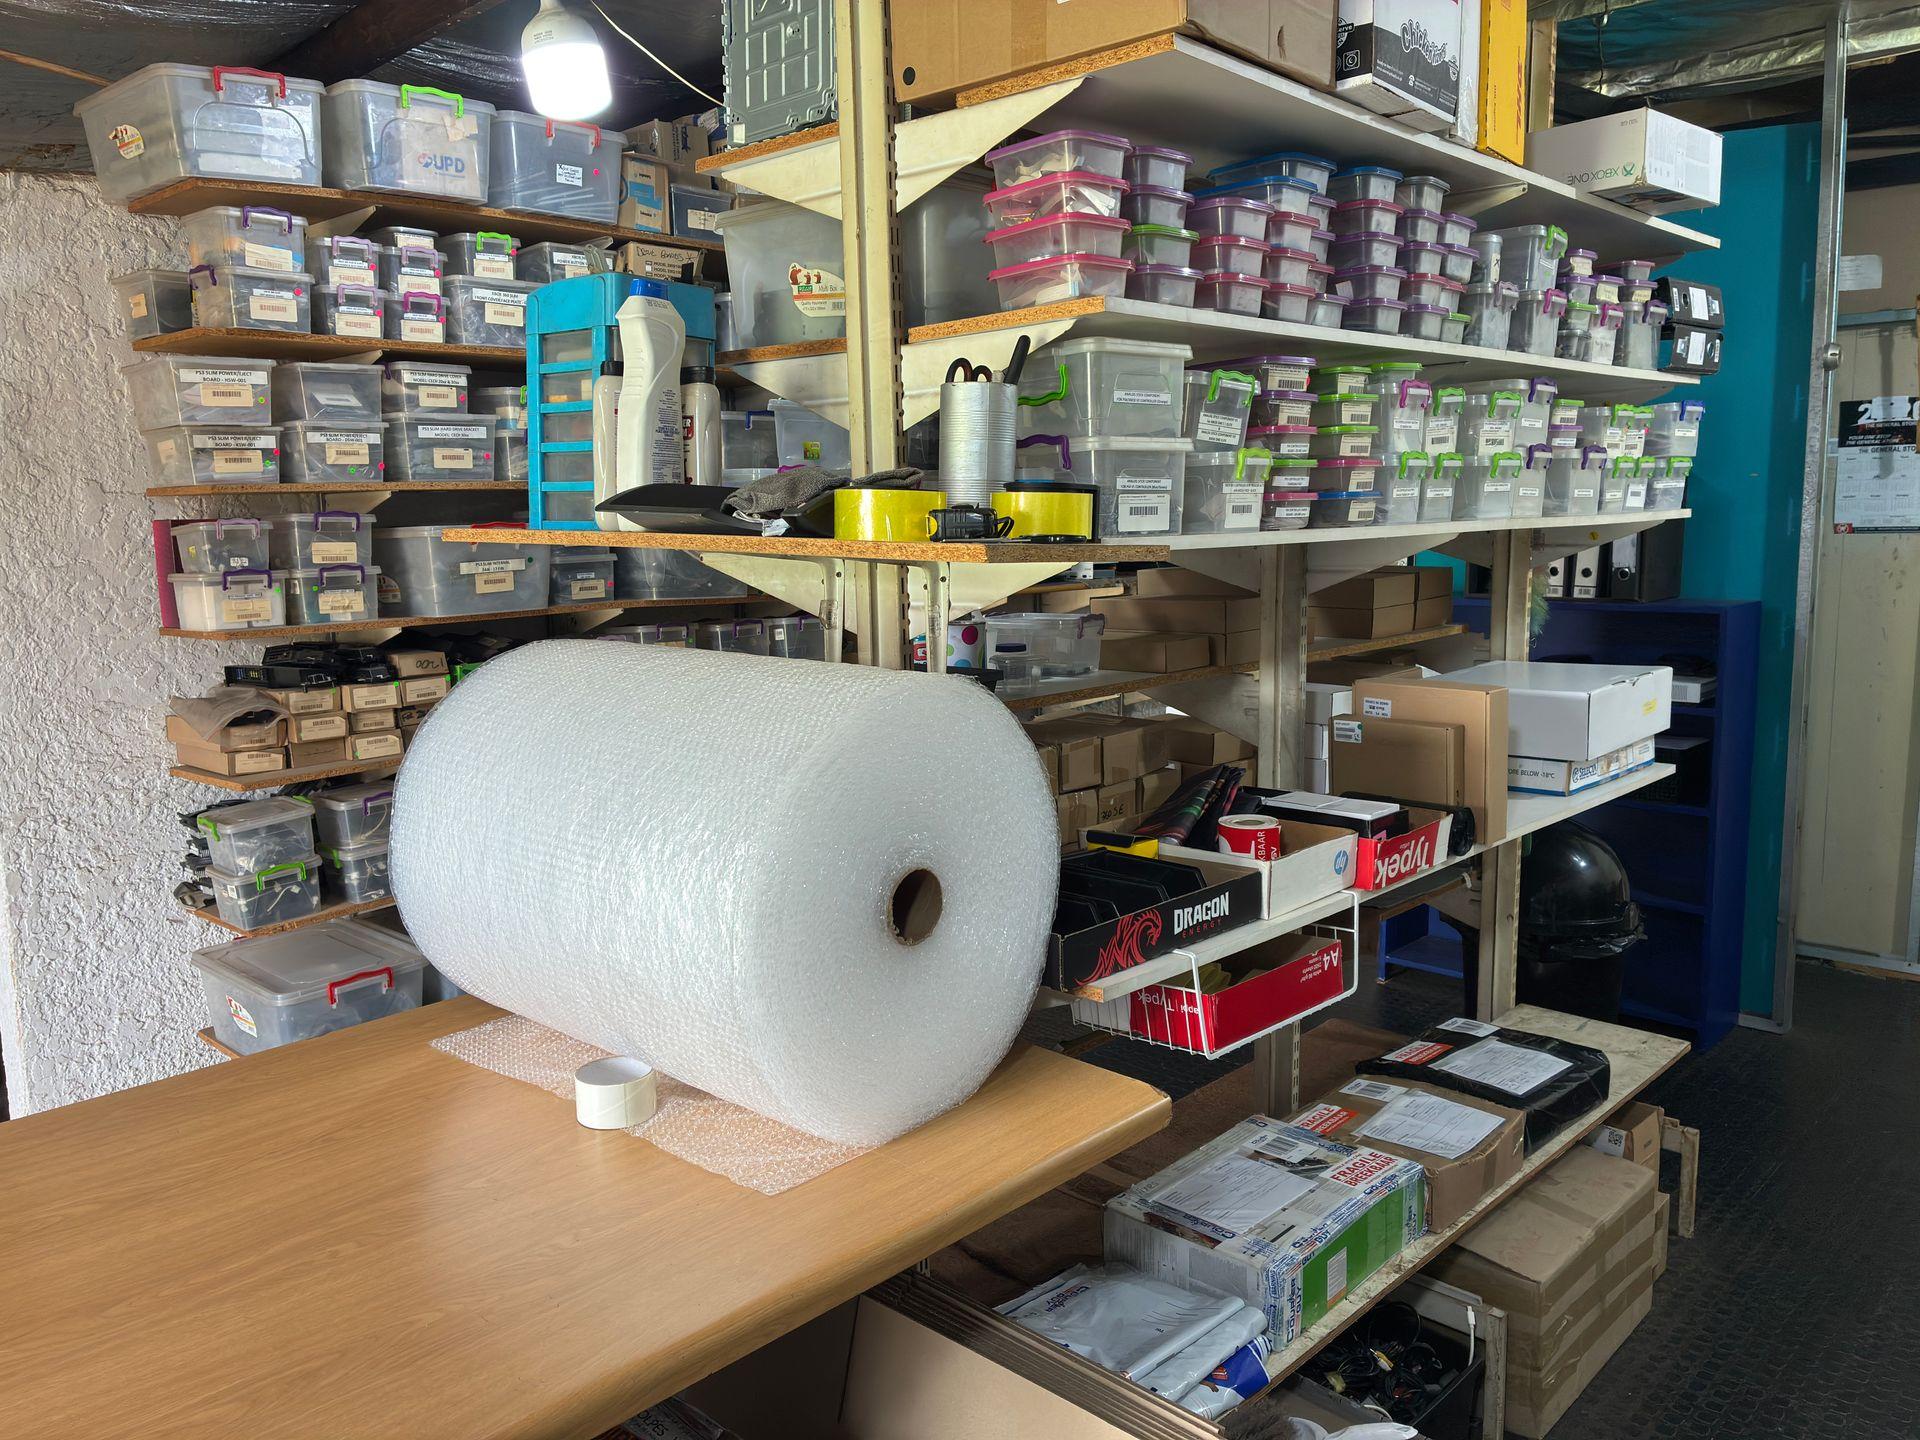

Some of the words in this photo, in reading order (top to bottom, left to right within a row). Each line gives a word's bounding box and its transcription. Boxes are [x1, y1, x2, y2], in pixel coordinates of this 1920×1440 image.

[434, 154, 465, 174] UPD
[1590, 166, 1620, 180] XBOX
[1567, 172, 1590, 186] ONE
[1256, 832, 1265, 861] KBAAR
[1336, 850, 1348, 875] hp
[1375, 835, 1430, 888] Typek
[1174, 891, 1230, 936] DRAGON
[1182, 918, 1222, 938] ENERGY
[1322, 947, 1339, 971] A4
[1137, 990, 1174, 1012] Typek
[1330, 1152, 1382, 1182] FRAGILE
[1344, 1156, 1396, 1186] BREEKBAAR
